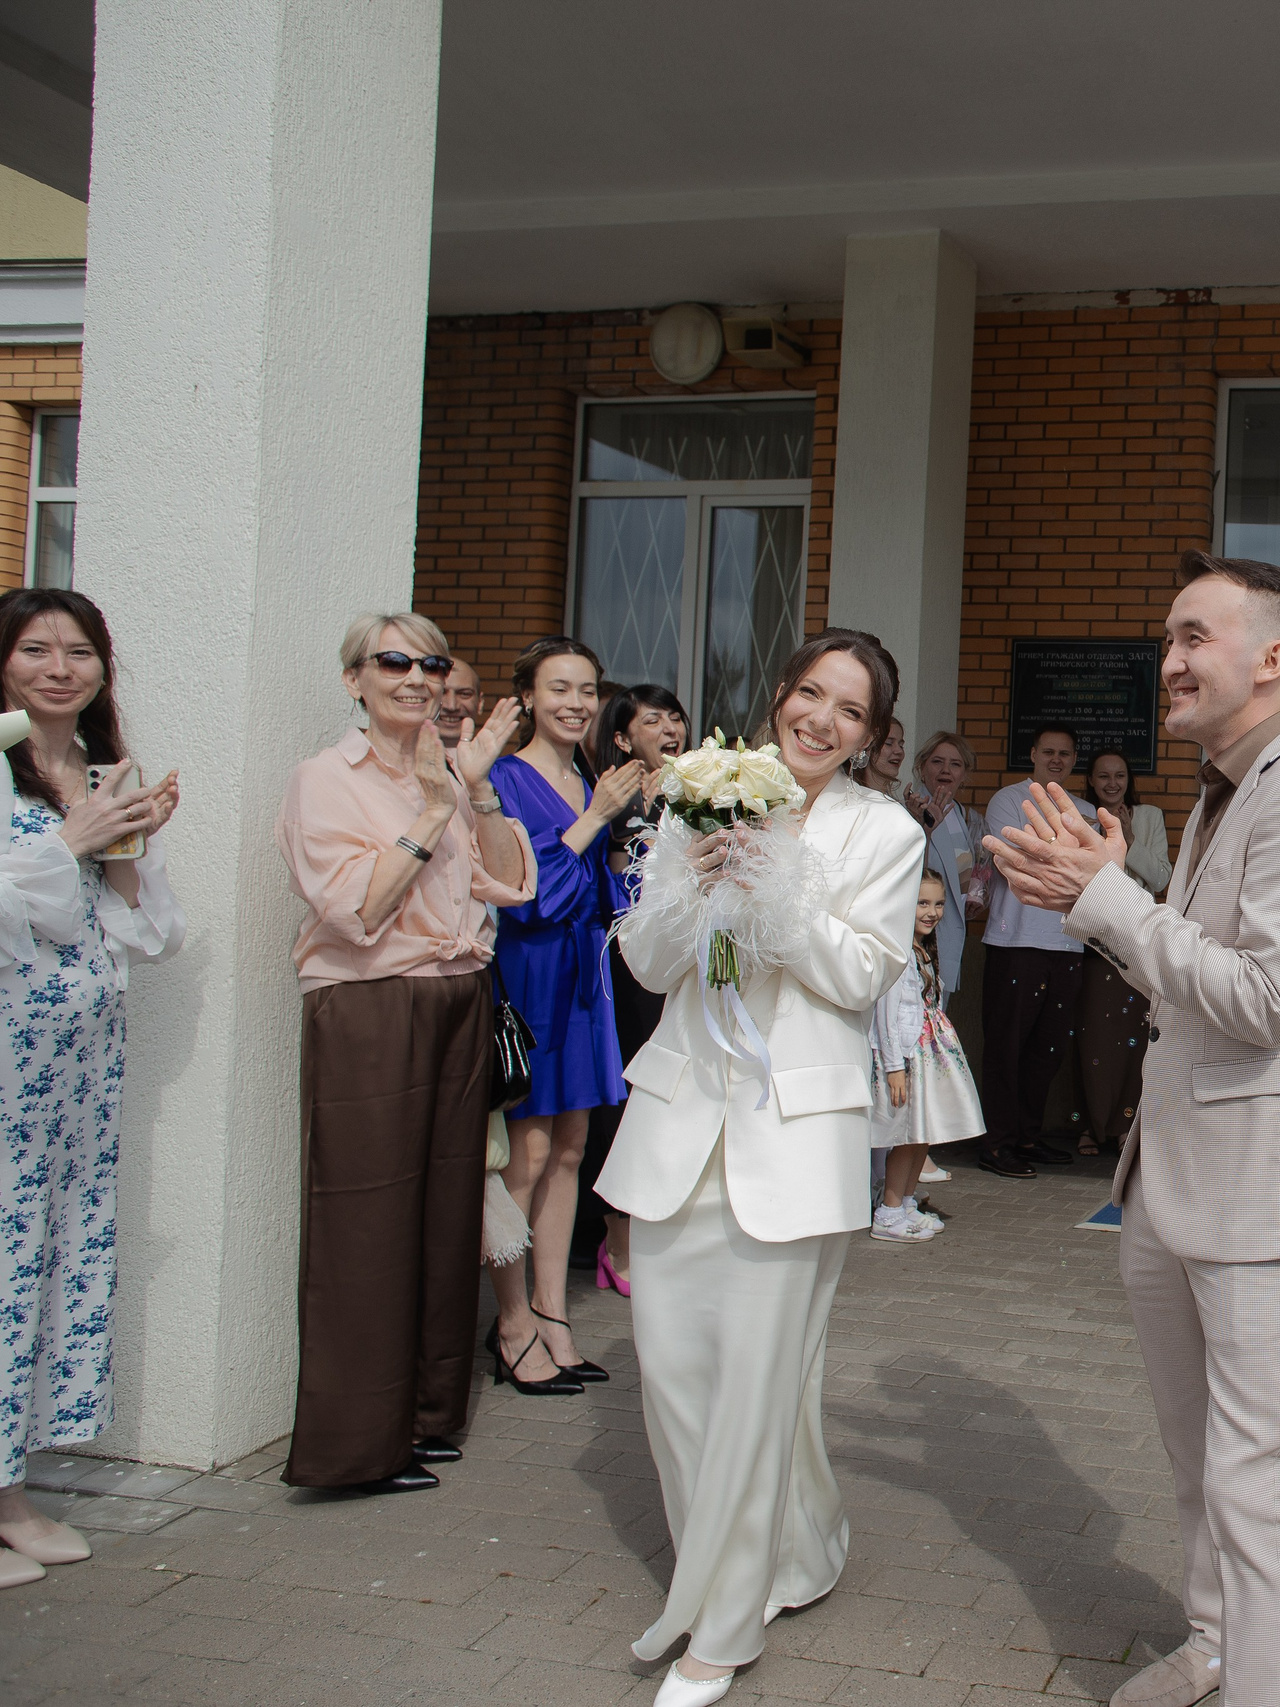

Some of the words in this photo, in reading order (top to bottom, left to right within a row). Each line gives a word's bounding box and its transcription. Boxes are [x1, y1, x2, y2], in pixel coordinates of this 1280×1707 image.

[1087, 653, 1123, 661] ОТДЕЛОМ
[1128, 652, 1154, 661] ЗАГС
[1099, 661, 1129, 669] РАЙОНА
